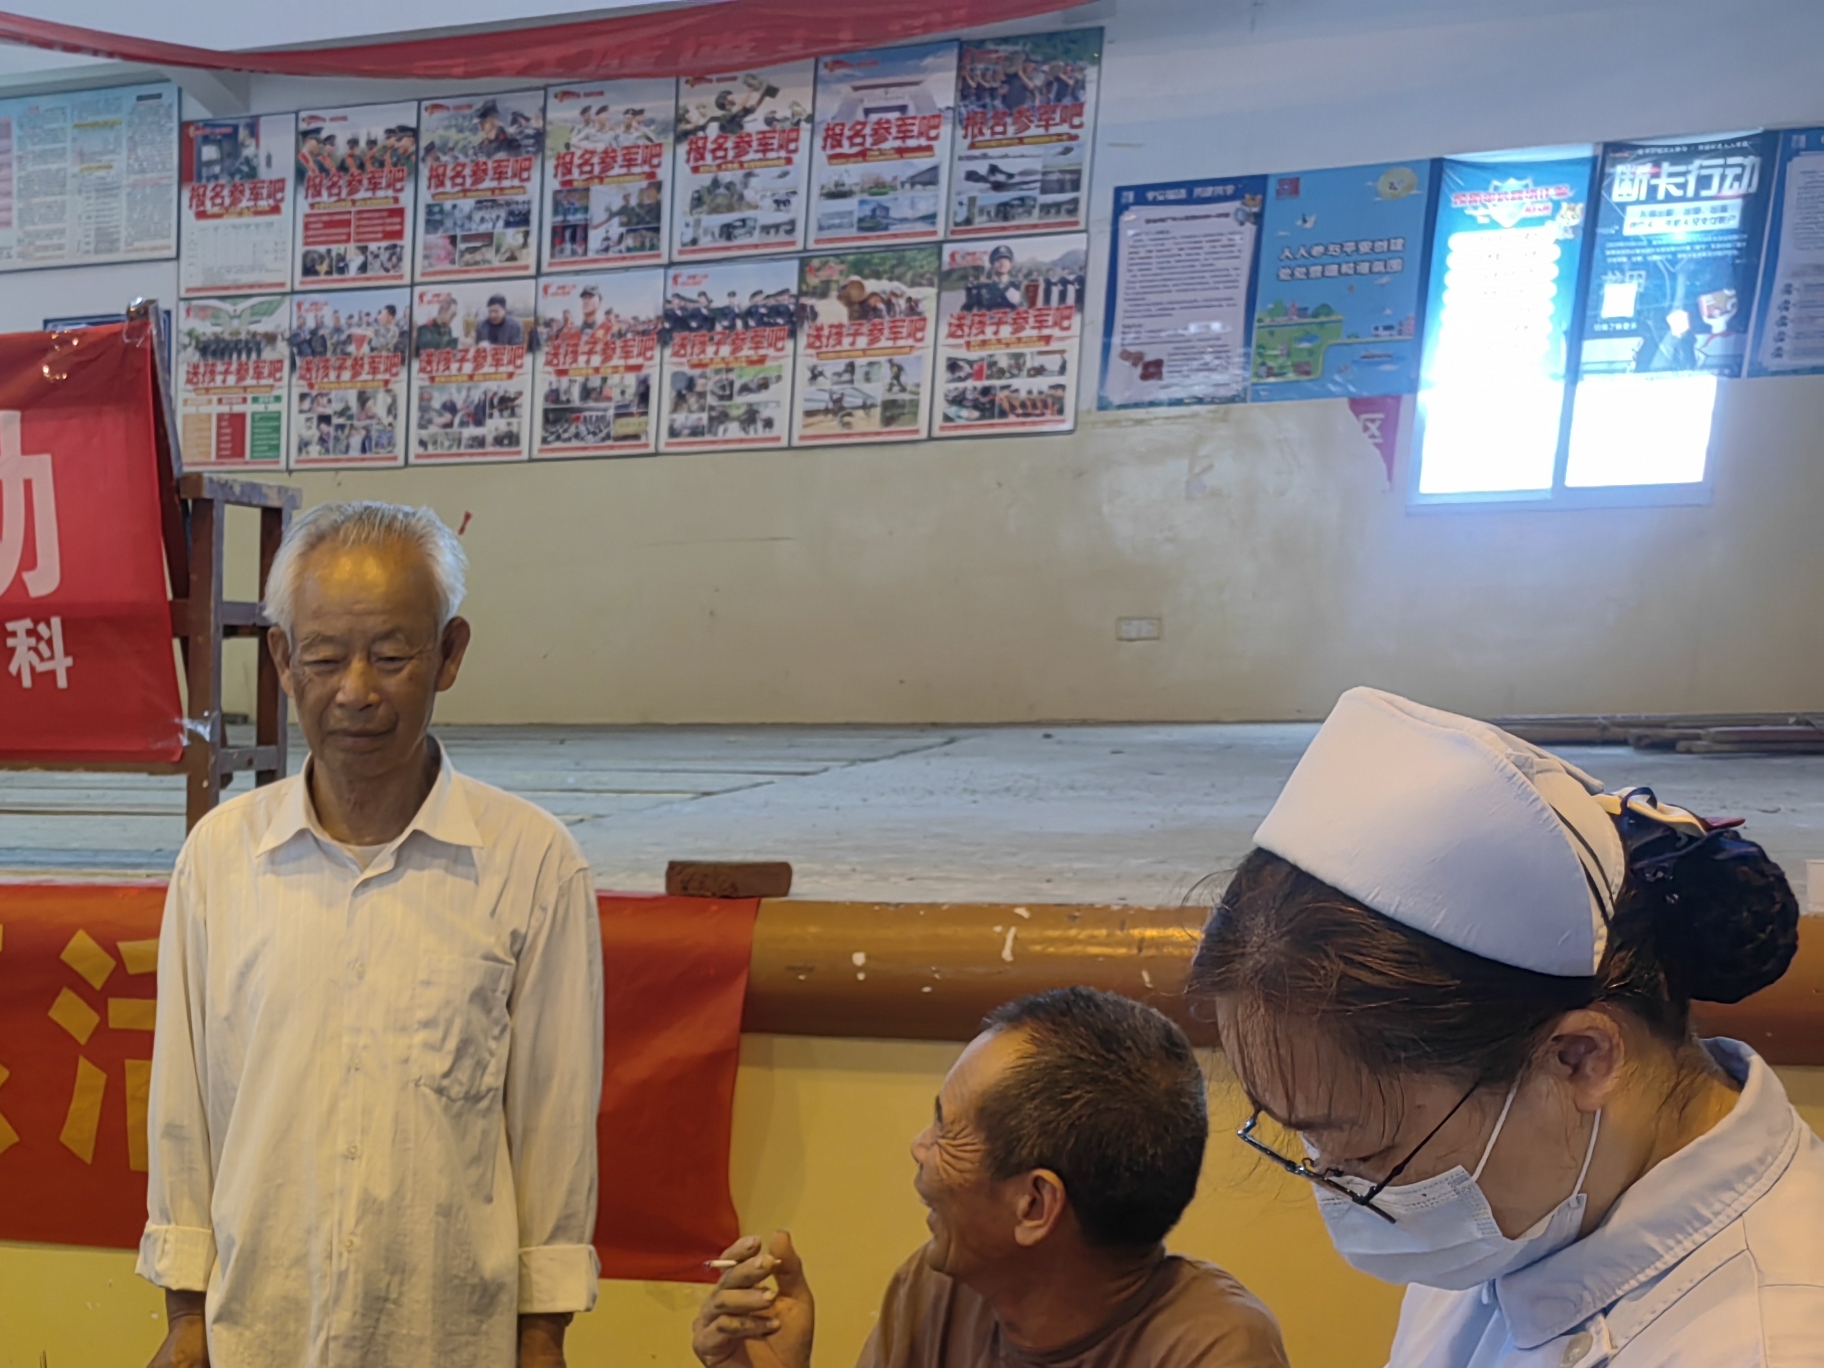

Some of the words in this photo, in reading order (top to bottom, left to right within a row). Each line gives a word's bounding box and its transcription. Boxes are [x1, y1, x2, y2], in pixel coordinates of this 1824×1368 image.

[821, 113, 943, 153] 报名参军吧
[961, 101, 1085, 140] 报名参军吧
[554, 142, 664, 179] 报名参军吧
[684, 126, 801, 166] 报名参军吧
[305, 166, 408, 201] 报名参军吧
[427, 156, 534, 191] 报名参军吧
[1612, 155, 1760, 201] 断卡行动
[189, 178, 286, 212] 报名参军吧
[805, 316, 928, 351] 送孩子参军吧
[946, 305, 1075, 340] 送孩子参军吧
[544, 334, 658, 368] 送孩子参军吧
[669, 325, 789, 359] 送孩子参军吧
[185, 358, 284, 386] 送孩子参军吧
[298, 352, 401, 382] 送孩子参军吧
[418, 345, 526, 375] 送孩子参军吧
